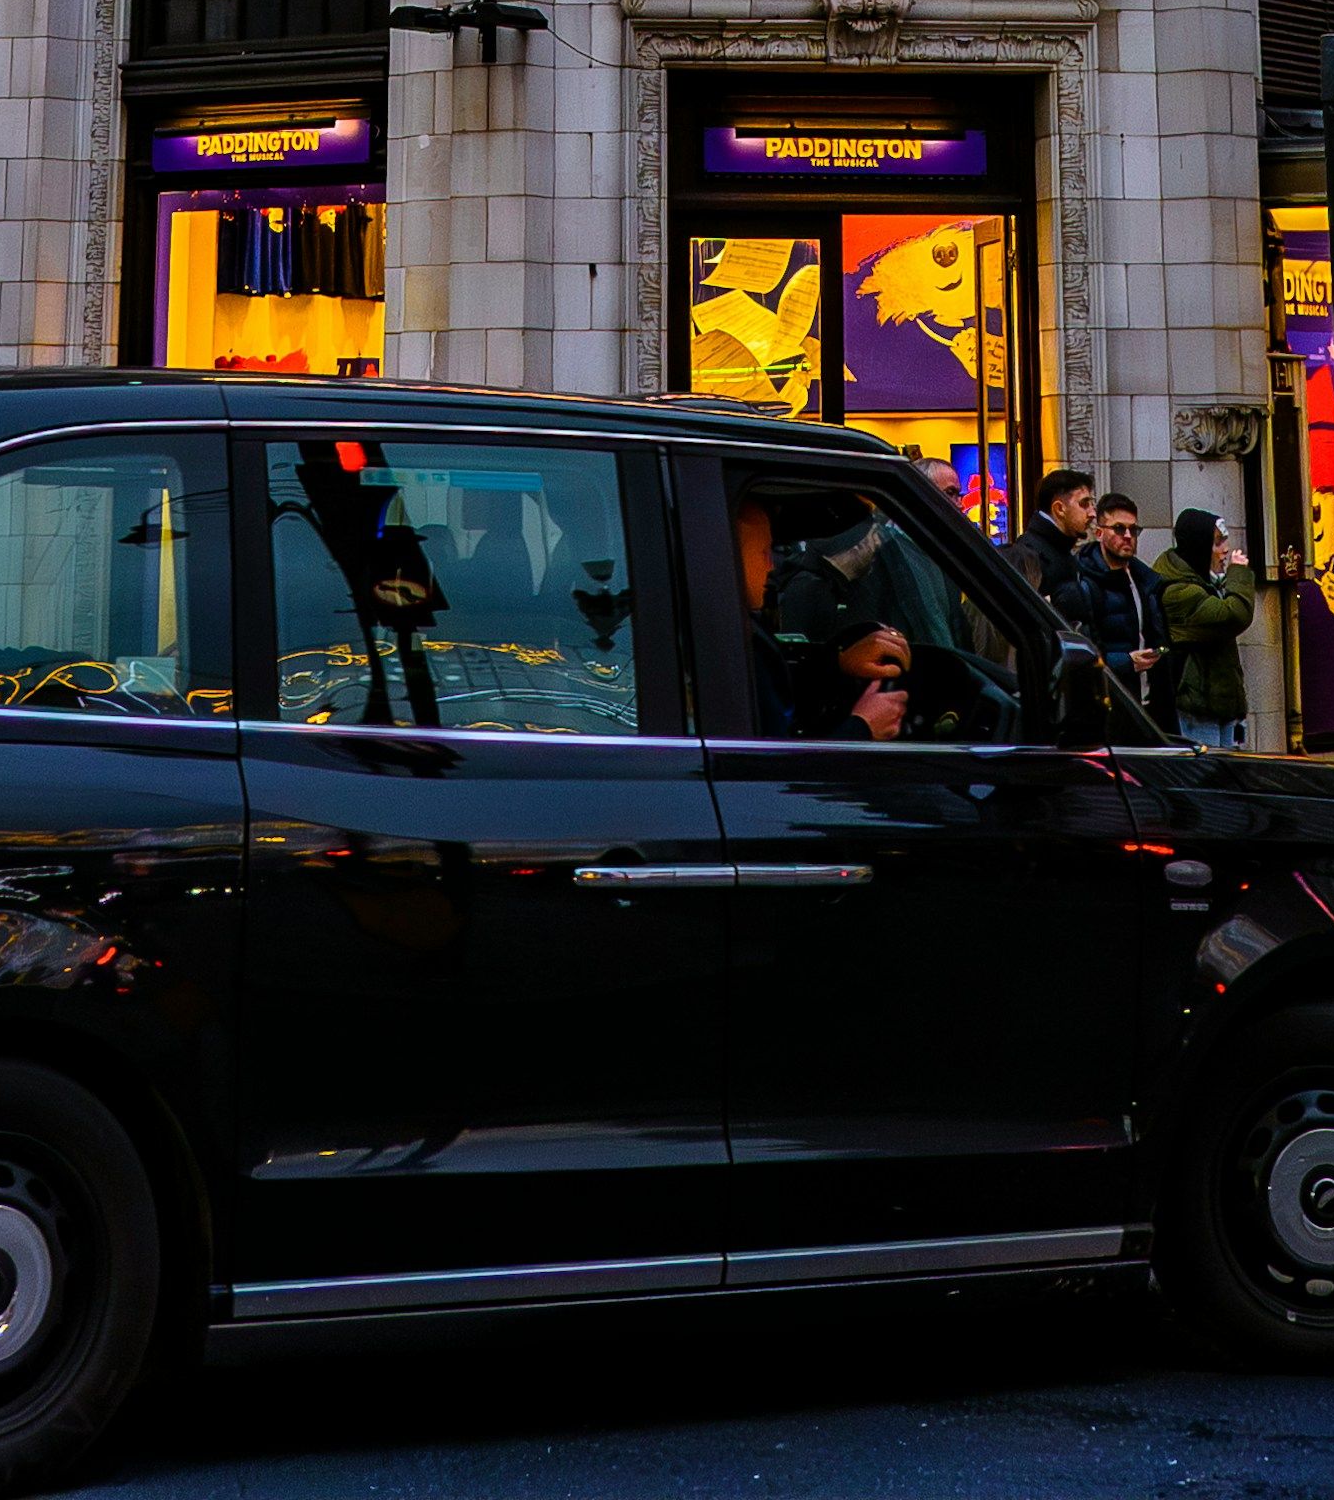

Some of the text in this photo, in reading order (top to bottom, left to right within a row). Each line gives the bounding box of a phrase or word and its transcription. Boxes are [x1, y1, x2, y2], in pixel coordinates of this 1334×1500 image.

[197, 131, 320, 157] PADDINGTON
[765, 138, 922, 160] PADDINGTON
[230, 152, 285, 162] THE MUSICAL
[810, 157, 880, 168] THE MUSICAL
[1297, 303, 1329, 317] MUSICAL
